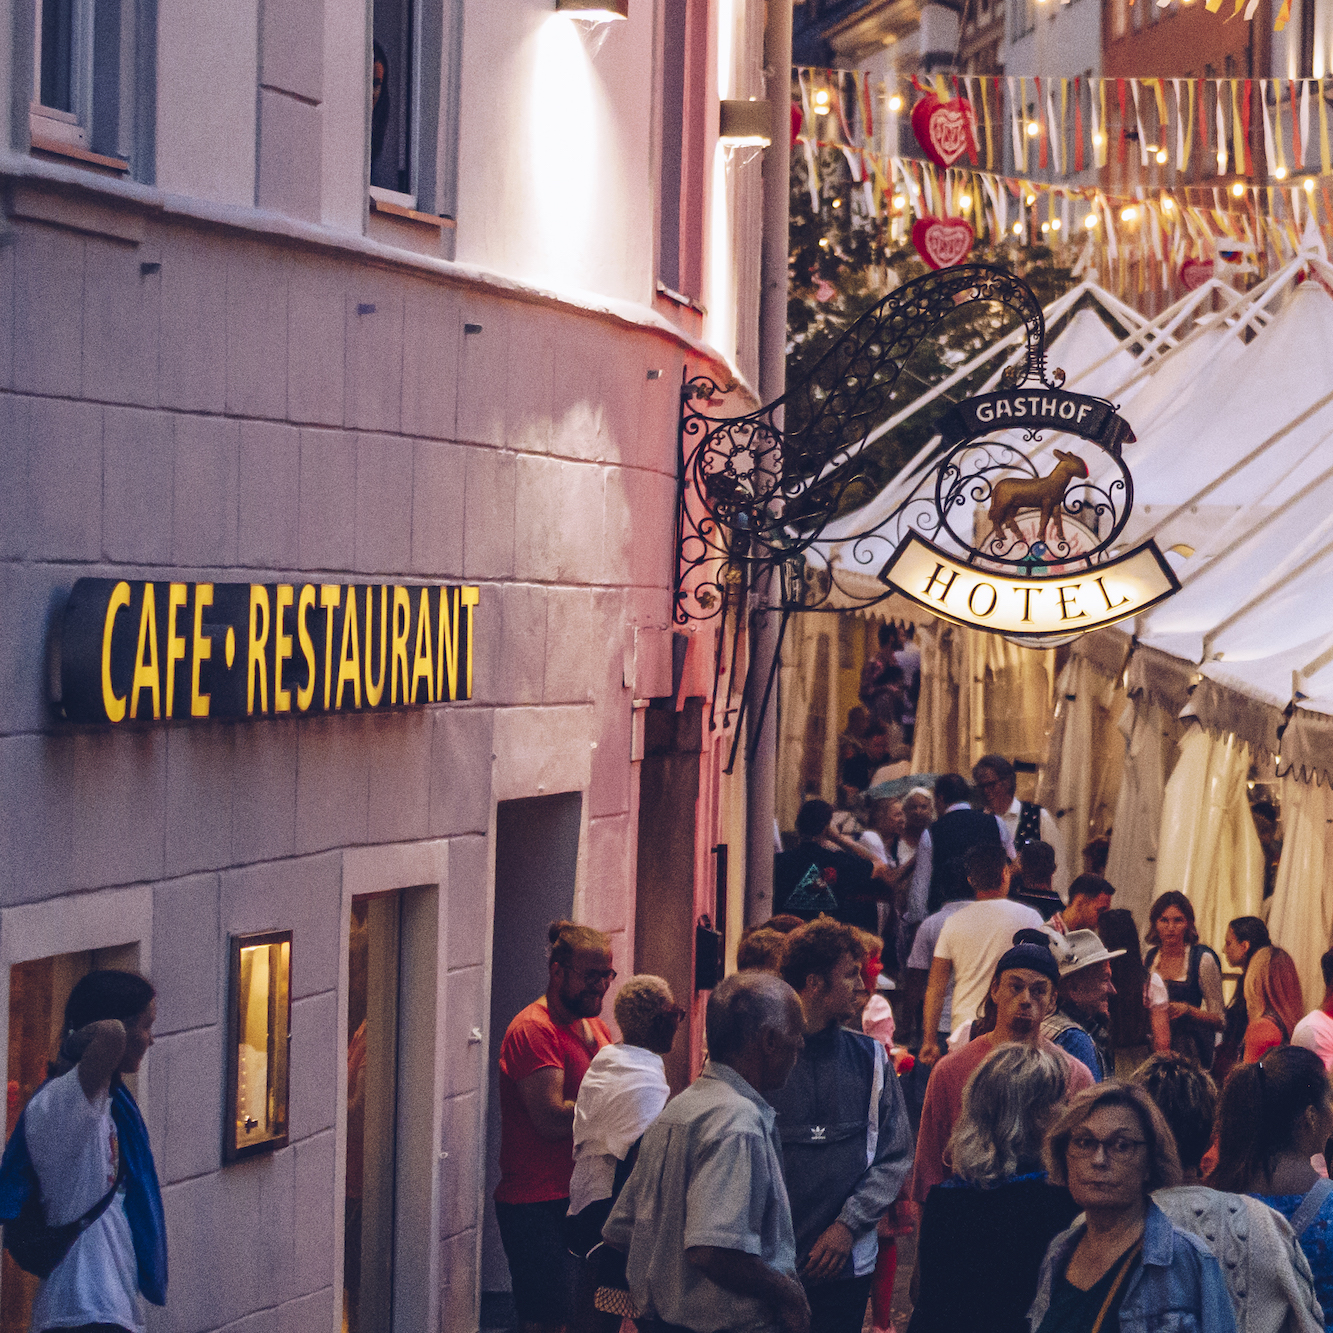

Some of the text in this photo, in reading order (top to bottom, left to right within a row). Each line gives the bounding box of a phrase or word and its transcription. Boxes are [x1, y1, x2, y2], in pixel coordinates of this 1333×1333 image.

[976, 397, 1093, 423] GASTHOF
[921, 563, 1131, 623] HOTEL
[102, 581, 480, 723] CAFE RESTAURANT
